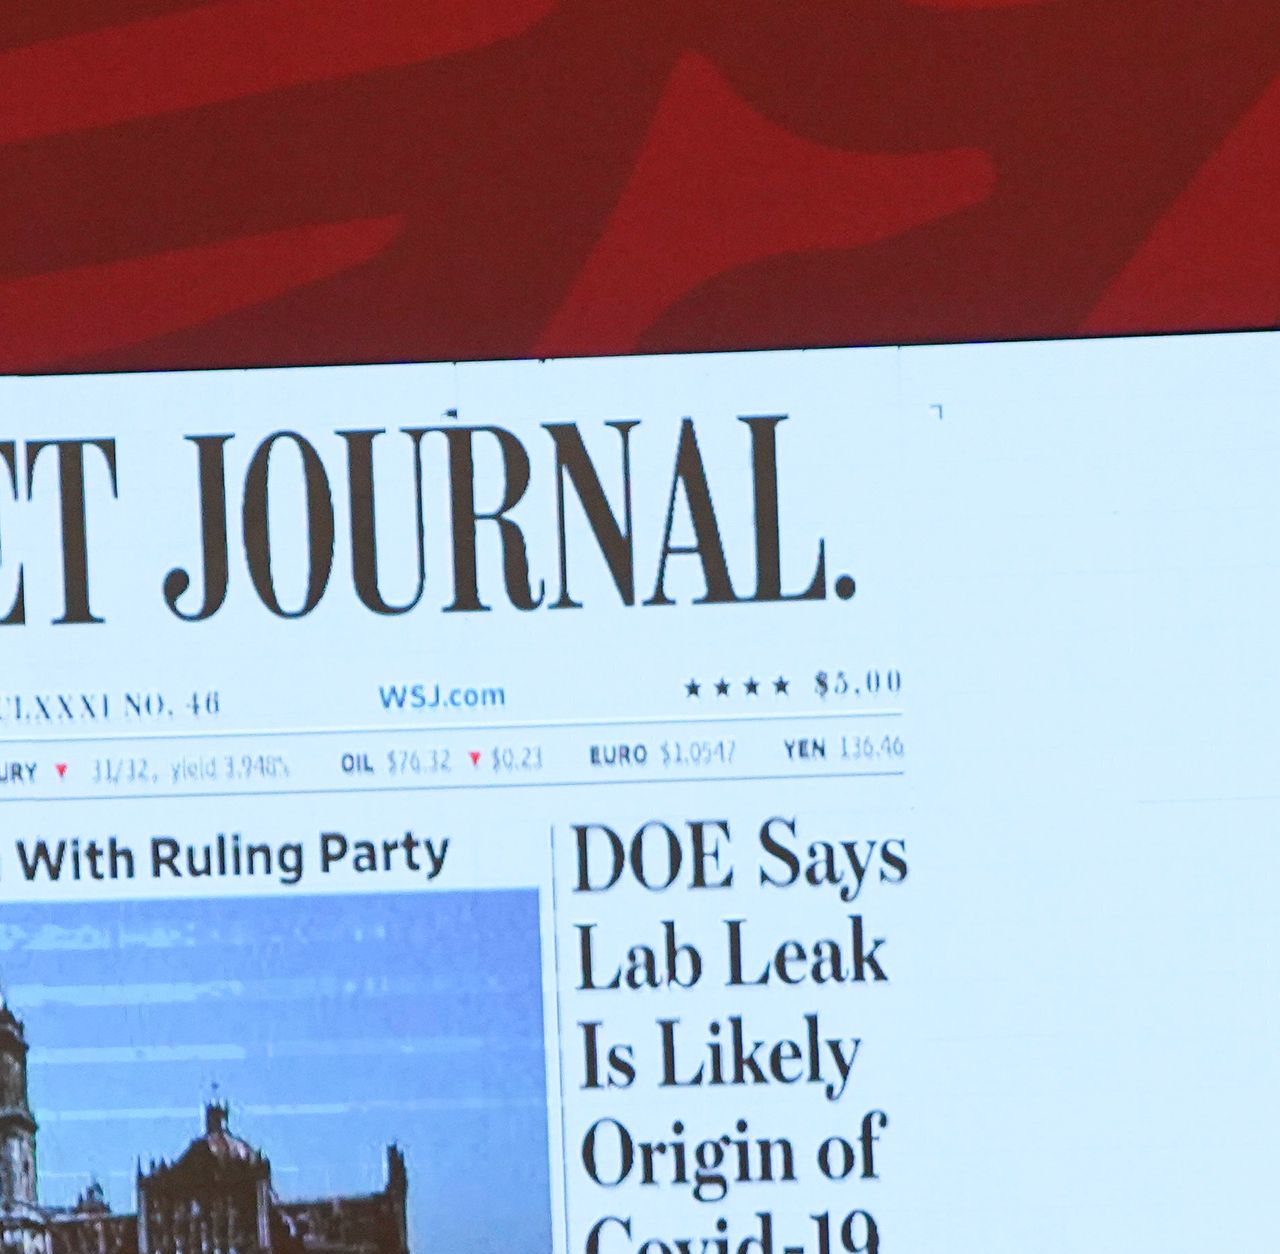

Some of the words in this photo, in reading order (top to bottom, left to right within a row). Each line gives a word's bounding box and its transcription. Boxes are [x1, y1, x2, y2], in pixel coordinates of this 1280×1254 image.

[156, 410, 857, 621] JOURNAL.
[124, 691, 174, 718] NO.
[186, 690, 221, 717] 46
[379, 684, 505, 709] WSJ.com
[815, 671, 901, 698] $5.00
[342, 750, 374, 776] OIL
[589, 744, 648, 766] EURO
[785, 739, 826, 759] YEN
[16, 836, 134, 881] With
[151, 833, 304, 886] Ruling
[320, 831, 449, 881] Party
[571, 820, 734, 892] DOE
[759, 817, 908, 902] Says
[573, 920, 703, 990] Lab
[724, 914, 889, 986] Leak
[578, 1021, 636, 1089] Is
[656, 1012, 861, 1101] Likely
[581, 1118, 797, 1203] Origin
[817, 1110, 888, 1180] of
